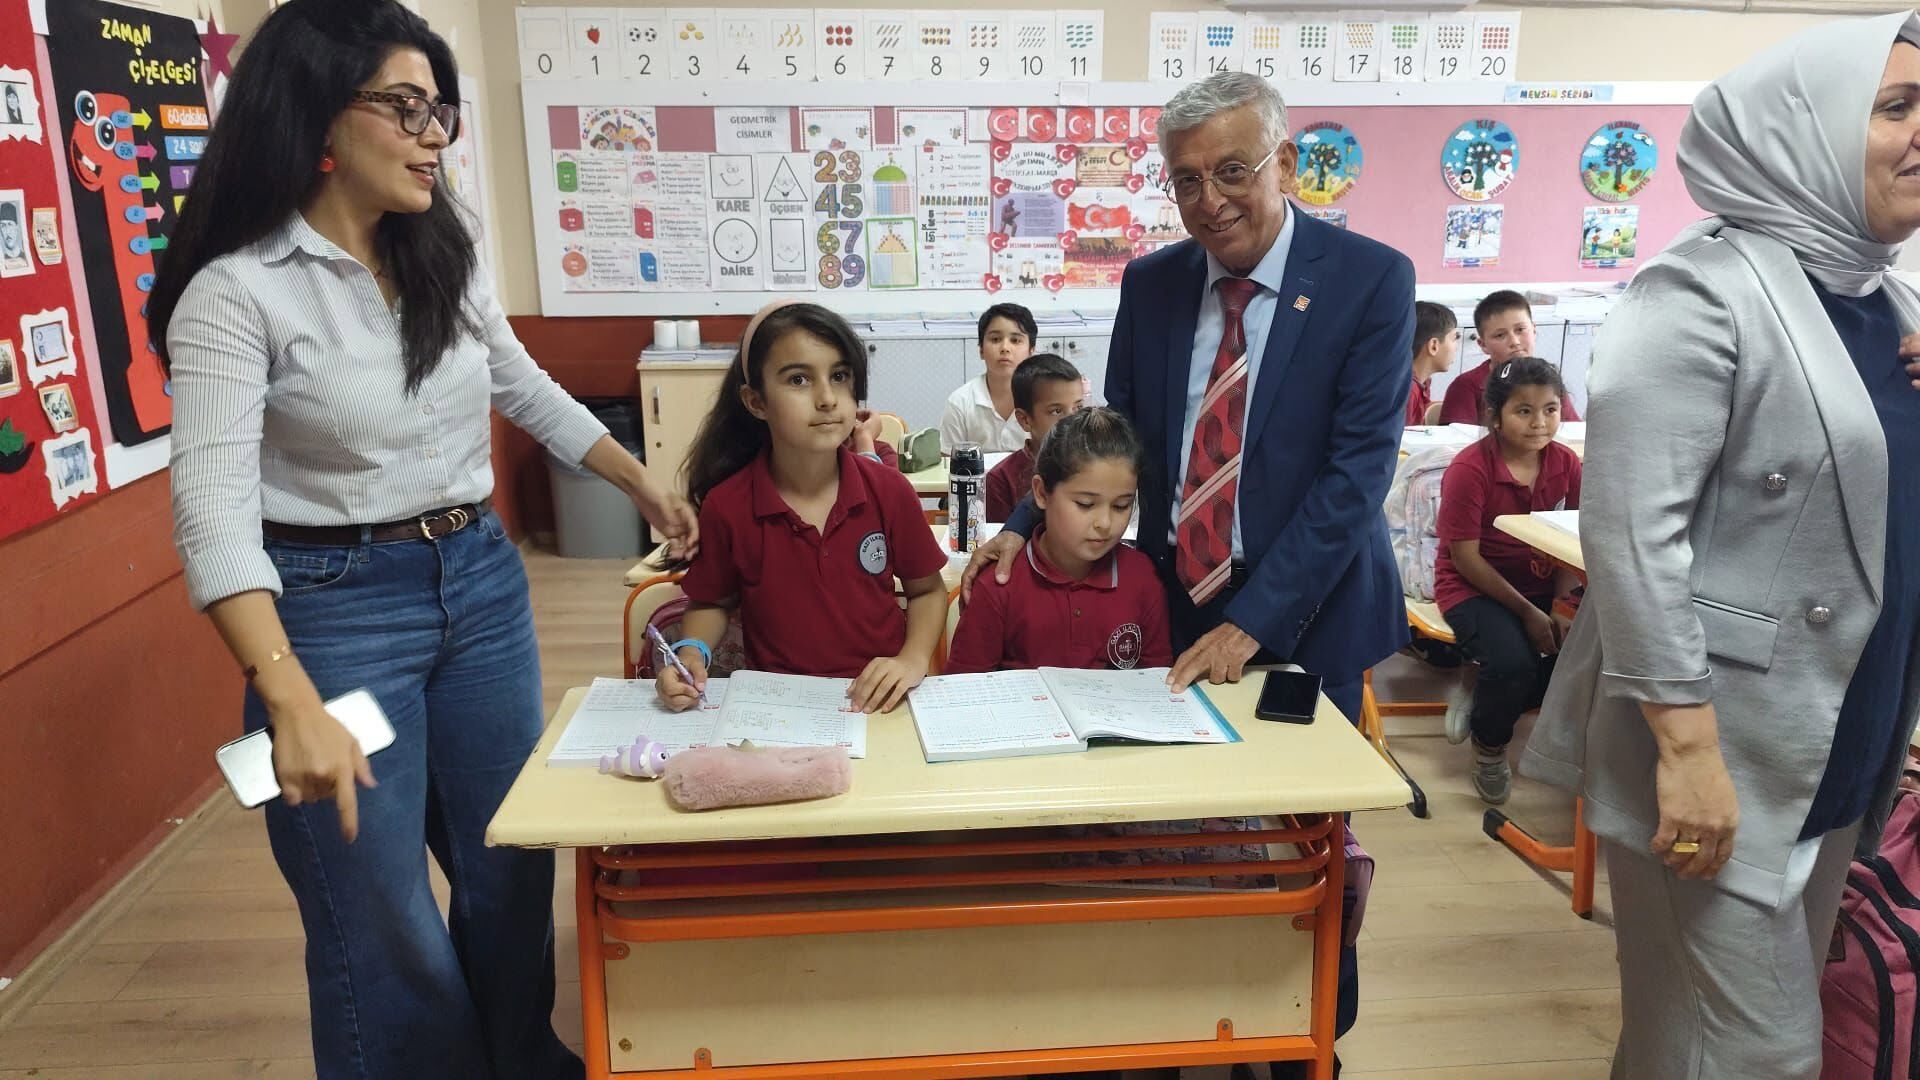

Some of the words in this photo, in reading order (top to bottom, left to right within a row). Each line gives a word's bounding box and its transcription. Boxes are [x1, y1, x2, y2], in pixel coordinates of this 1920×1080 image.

[101, 19, 151, 48] ZAMAN
[129, 48, 196, 85] ÇİZELGESİ
[538, 54, 552, 74] 0
[590, 55, 599, 75] 1
[639, 55, 651, 75] 2
[688, 55, 700, 76] 3
[736, 55, 750, 75] 4
[785, 55, 797, 76] 5
[834, 55, 846, 75] 6
[883, 56, 895, 76] 7
[930, 55, 942, 76] 8
[979, 56, 990, 76] 9
[1020, 56, 1043, 76] 10
[1070, 56, 1087, 76] 11
[1163, 58, 1183, 78] 13
[1208, 56, 1229, 73] 14
[1255, 57, 1274, 78] 15
[1302, 56, 1322, 76] 16
[1348, 54, 1369, 74] 17
[1393, 56, 1412, 75] 18
[1439, 57, 1457, 76] 19
[1481, 56, 1506, 76] 20
[730, 114, 777, 124] GEOMETRİK
[173, 138, 187, 154] 24
[716, 200, 750, 212] KARE
[720, 264, 754, 276] DAİRE
